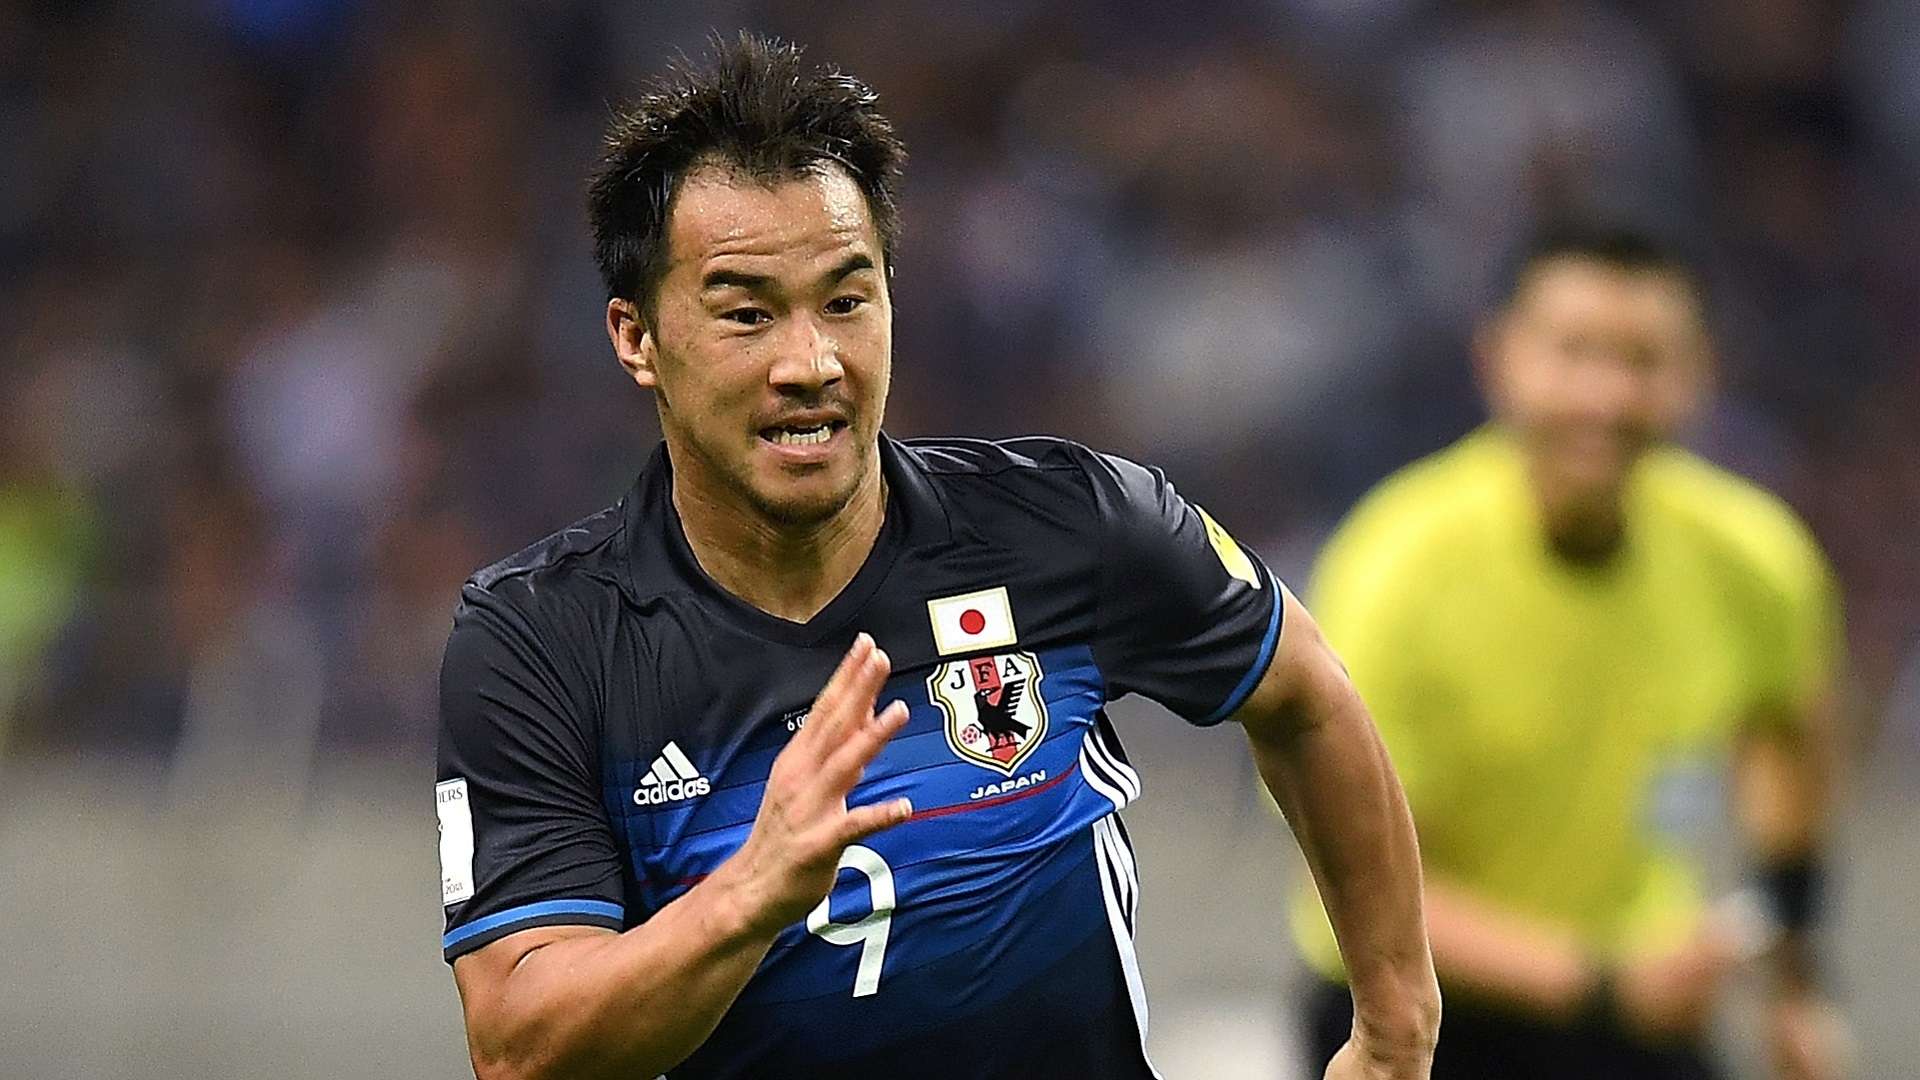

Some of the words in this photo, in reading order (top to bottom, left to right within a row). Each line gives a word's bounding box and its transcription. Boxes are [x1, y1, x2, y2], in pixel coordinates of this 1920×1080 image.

[950, 657, 1022, 690] JFA
[633, 777, 711, 805] adidas
[970, 769, 1046, 799] JAPAN
[806, 844, 896, 998] 9
